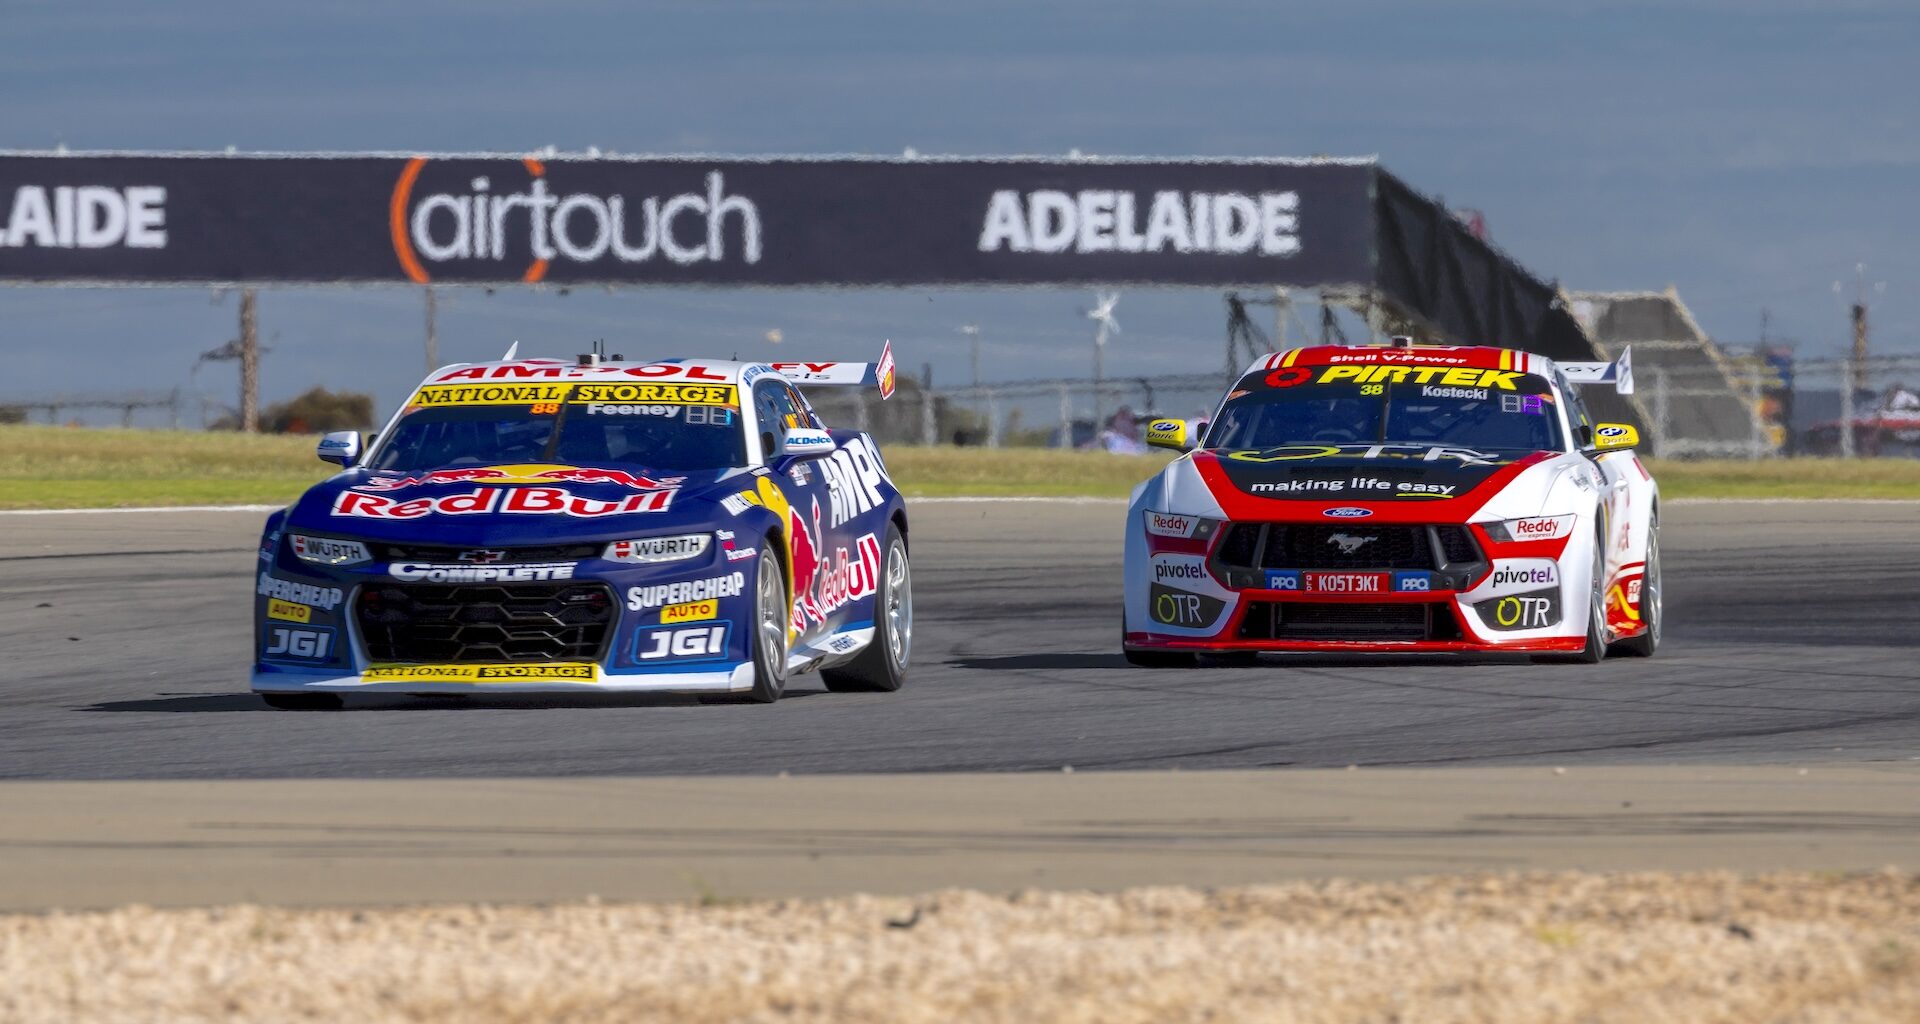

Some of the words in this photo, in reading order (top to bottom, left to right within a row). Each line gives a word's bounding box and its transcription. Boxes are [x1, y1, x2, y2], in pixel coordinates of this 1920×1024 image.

[411, 170, 763, 263] airtouch
[978, 189, 1301, 256] ADELAIDE
[1330, 354, 1377, 362] Shell
[1382, 354, 1467, 363] V-Power
[1316, 364, 1526, 391] PIRTEK
[417, 385, 560, 405] NATIONAL
[577, 385, 727, 404] STORAGE
[1360, 384, 1384, 396] 38
[1422, 385, 1488, 400] Kostecki
[530, 403, 559, 415] 88
[587, 403, 681, 419] Feeney
[785, 436, 832, 446] ACDelco
[1251, 478, 1346, 493] making
[1350, 476, 1392, 491] life
[1396, 481, 1457, 495] easy
[331, 488, 501, 518] Red
[503, 488, 680, 517] Bull
[1153, 515, 1189, 535] Reddy
[1517, 518, 1559, 537] Reddy
[307, 540, 361, 559] WÜRTH
[634, 538, 700, 556] WÜRTH
[627, 572, 745, 612] SUPERCHEAP
[1271, 577, 1297, 590] PPQ
[1402, 578, 1429, 591] PPQ
[272, 603, 307, 618] AUTO
[667, 605, 711, 618] AUTO
[1157, 595, 1203, 624] OTR
[1497, 597, 1550, 626] OTR
[266, 628, 330, 658] JGI
[640, 627, 726, 658] JGI
[365, 667, 474, 677] NATIONAL
[484, 666, 590, 677] STORAGE
